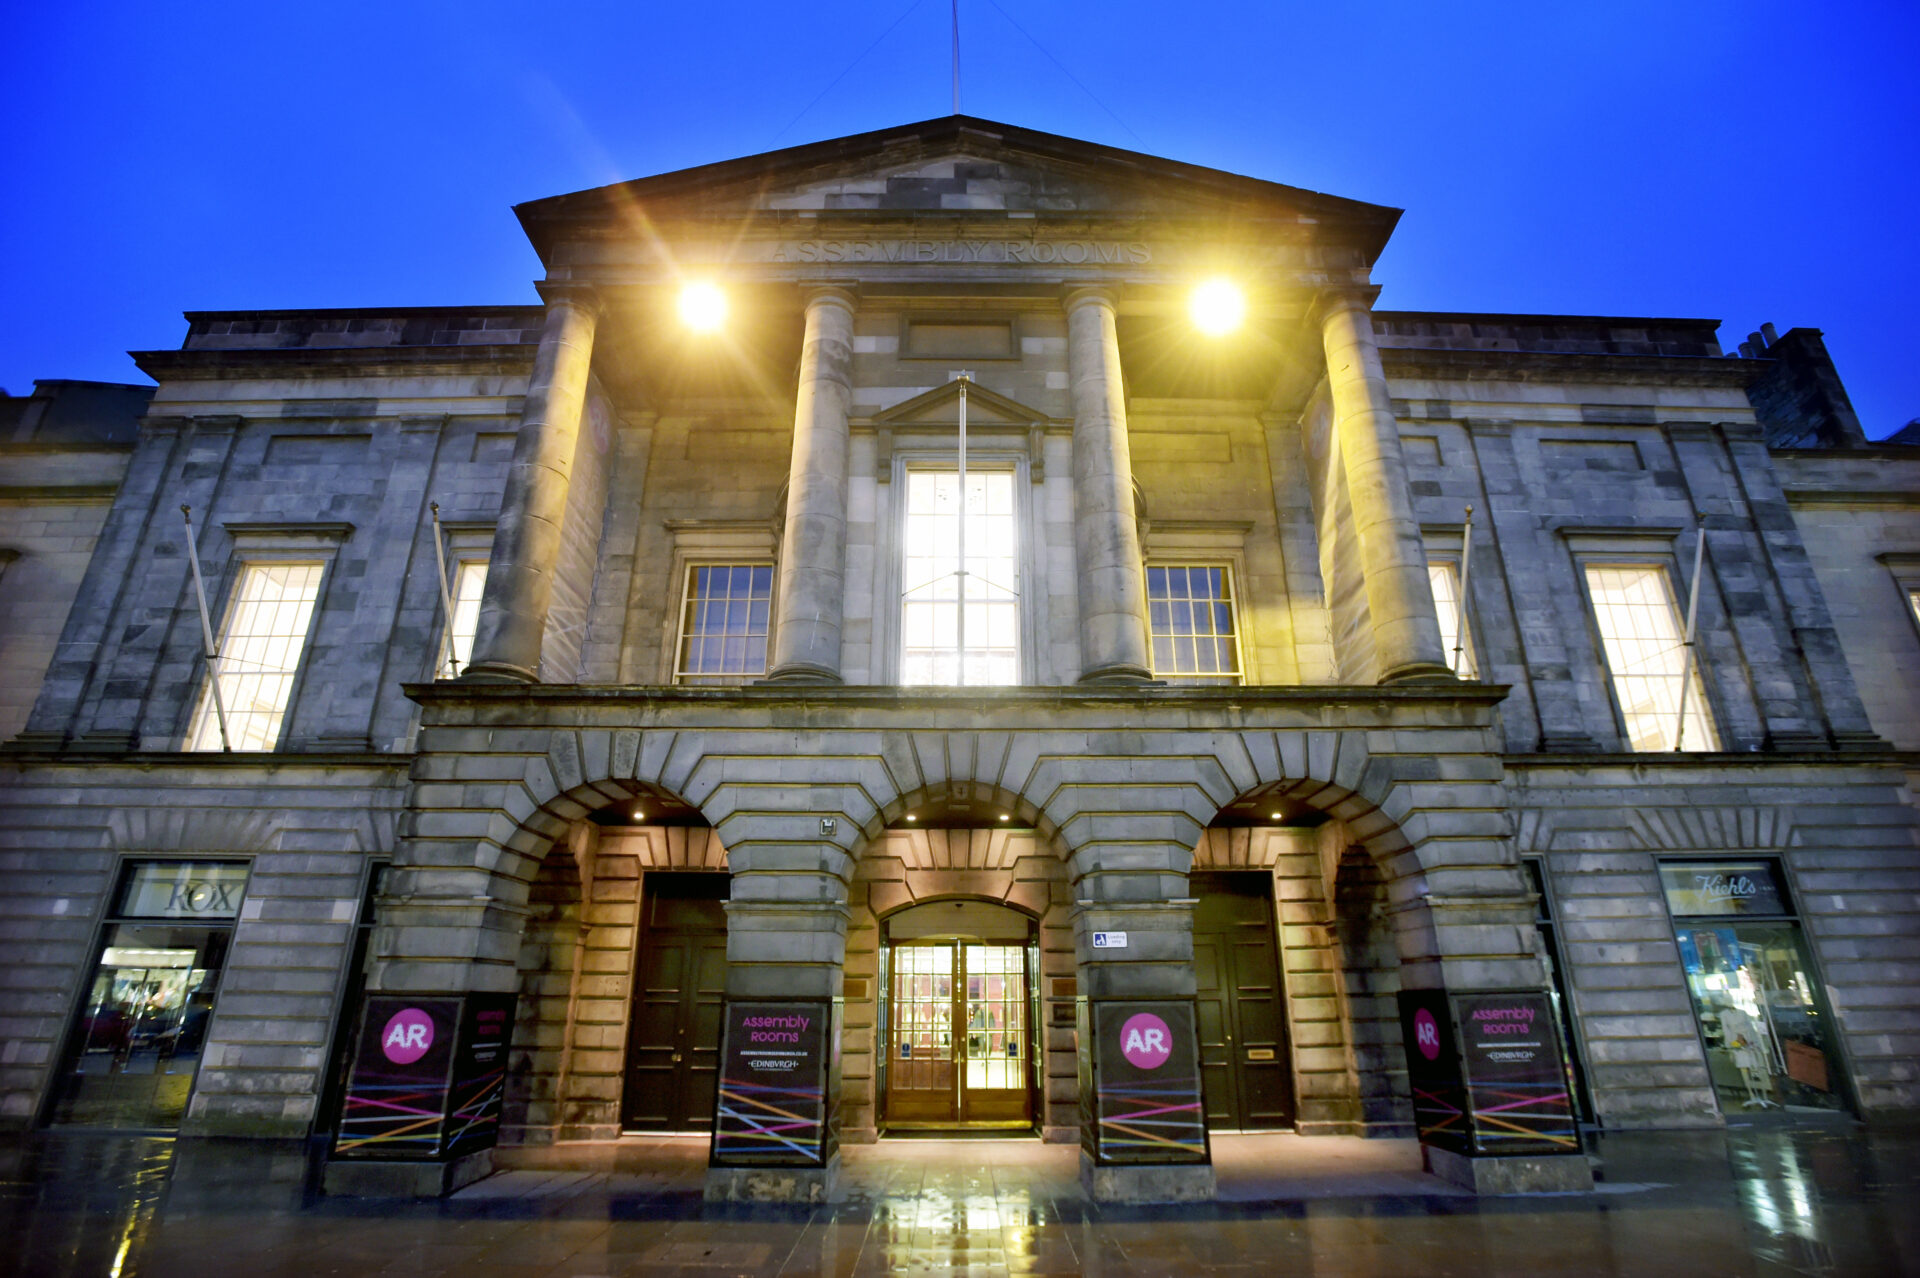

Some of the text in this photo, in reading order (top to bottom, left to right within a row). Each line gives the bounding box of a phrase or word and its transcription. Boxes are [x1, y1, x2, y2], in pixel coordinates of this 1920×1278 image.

[772, 240, 1153, 264] ASSEMBLY ROOMS
[1695, 874, 1757, 897] Kiehl's
[164, 882, 238, 912] ROX
[743, 1014, 810, 1032] Assembly
[1472, 1006, 1535, 1022] Assembly
[751, 1031, 799, 1043] Rooms
[1483, 1023, 1529, 1034] Rooms
